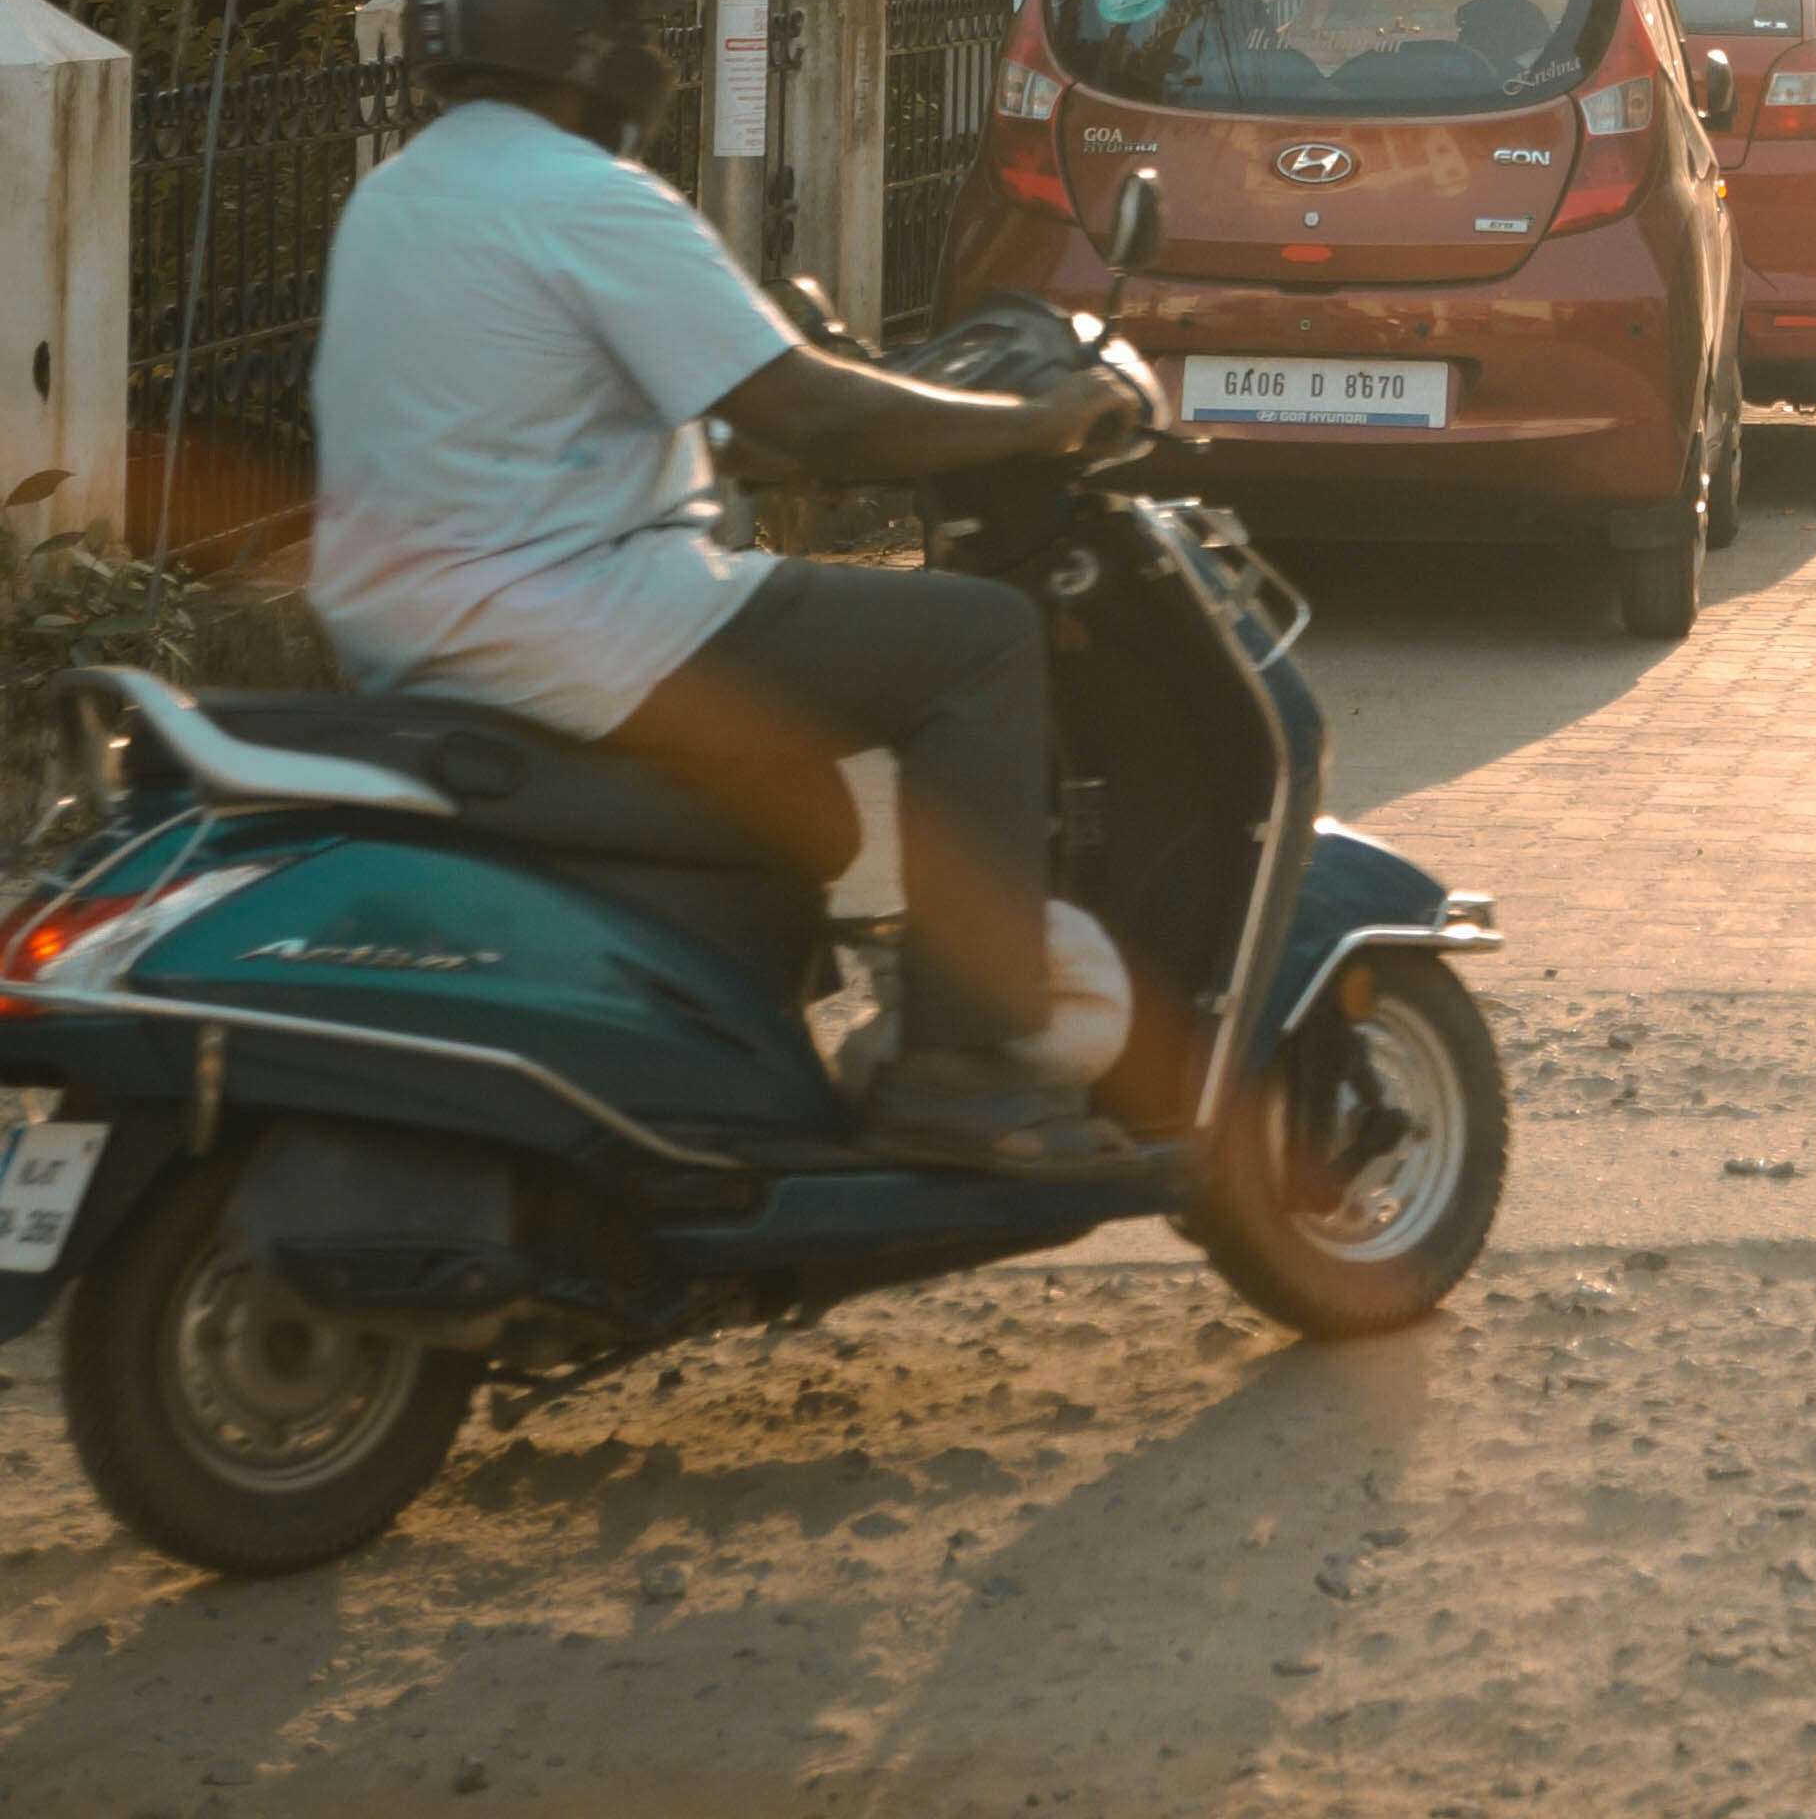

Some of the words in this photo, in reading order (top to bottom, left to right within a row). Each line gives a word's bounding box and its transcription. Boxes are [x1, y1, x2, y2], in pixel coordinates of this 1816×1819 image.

[1083, 127, 1123, 143] GOA
[1493, 149, 1551, 166] EON
[1224, 370, 1286, 397] GA06
[1311, 373, 1324, 398] D
[1345, 373, 1405, 400] 8670
[1280, 411, 1306, 422] GOA
[1309, 411, 1368, 425] HYUNDAI
